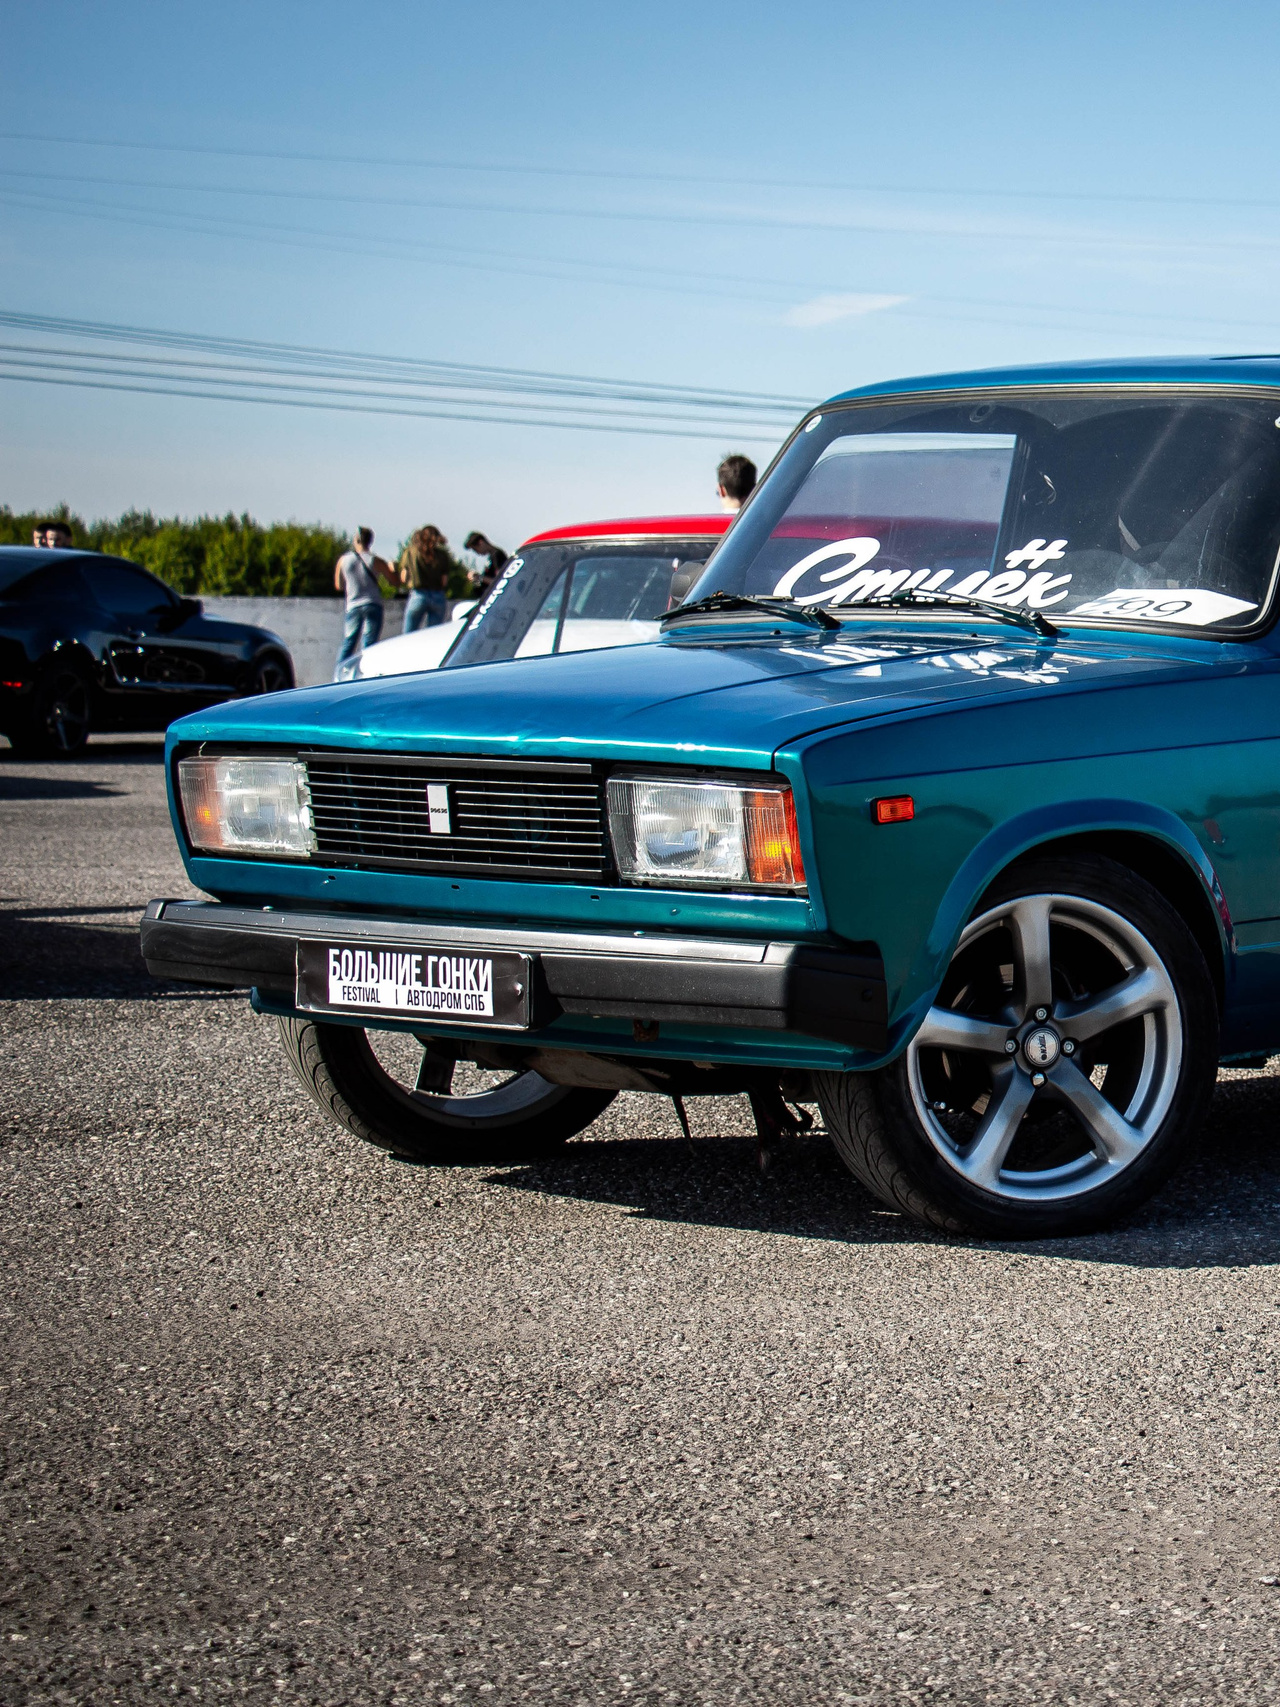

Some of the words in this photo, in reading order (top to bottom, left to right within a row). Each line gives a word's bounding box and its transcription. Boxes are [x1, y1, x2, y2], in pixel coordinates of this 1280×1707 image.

[328, 948, 422, 986] БОЛЬШИЕ
[427, 955, 493, 992] ГОНКИ
[342, 985, 381, 1004] FESTIVAL
[406, 991, 462, 1011] АВТОДРОМ
[464, 993, 486, 1012] СПБ
